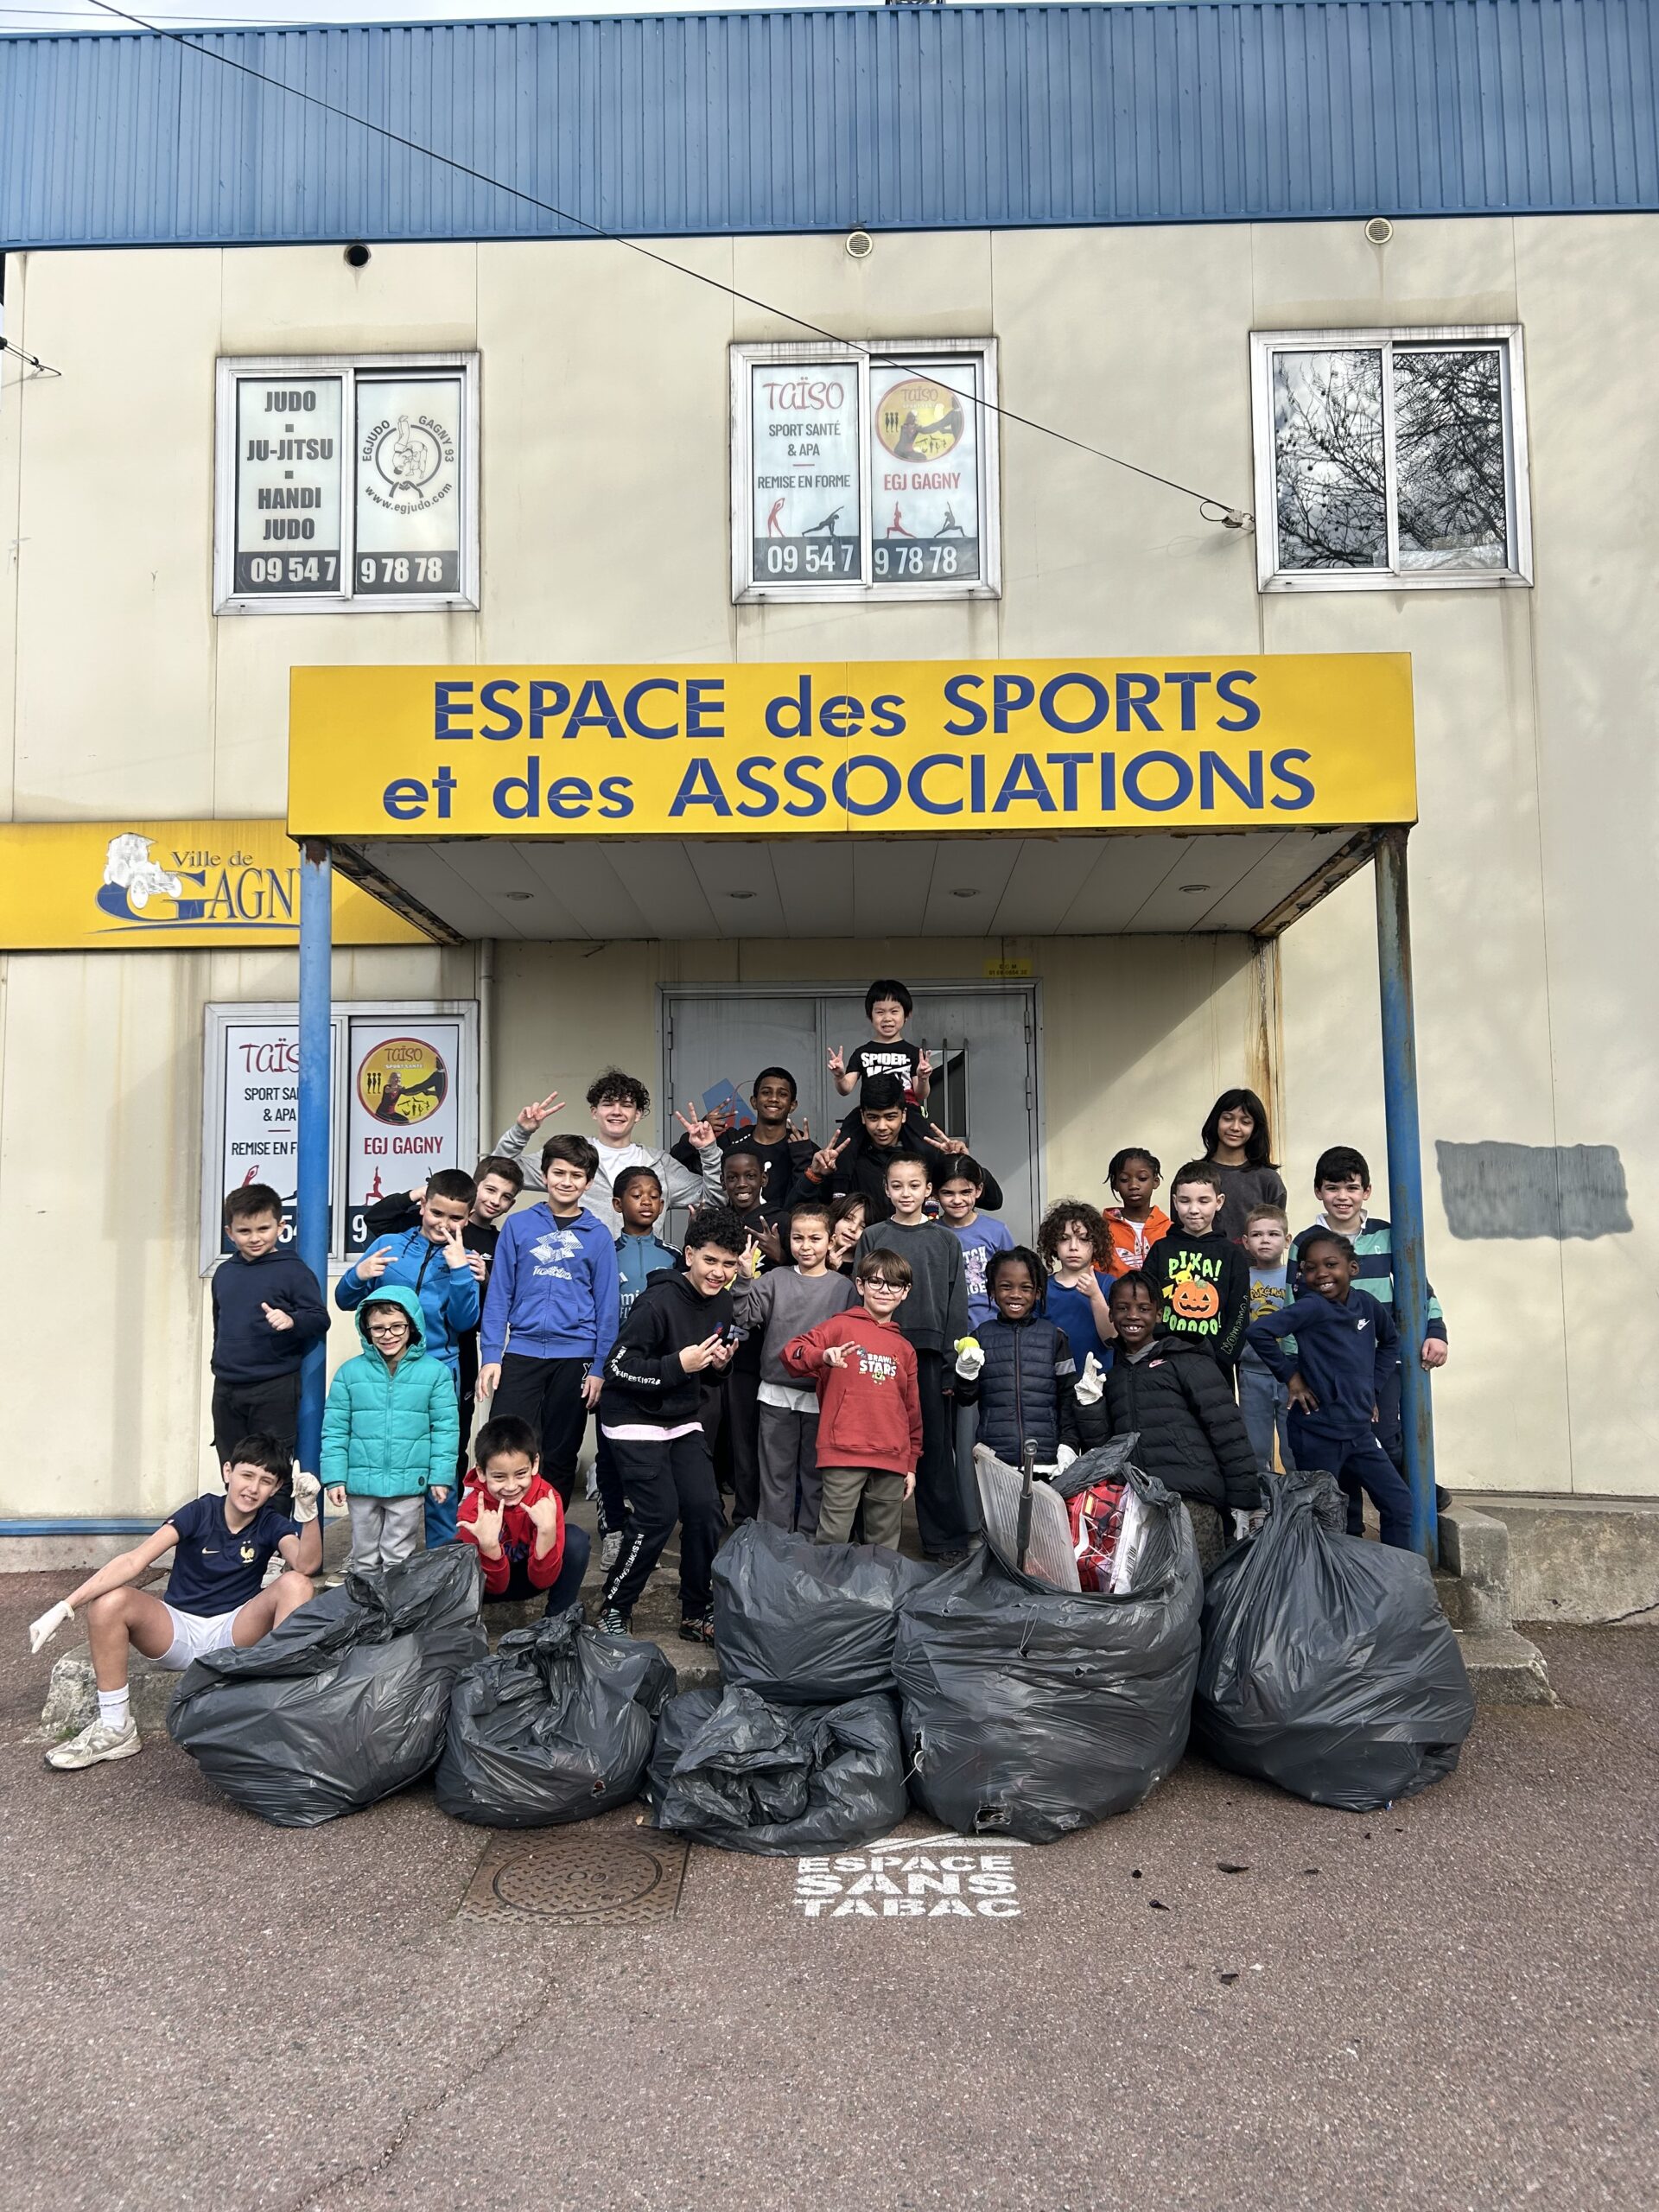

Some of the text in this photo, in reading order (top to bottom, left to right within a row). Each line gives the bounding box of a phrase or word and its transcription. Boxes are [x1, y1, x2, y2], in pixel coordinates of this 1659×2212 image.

[264, 391, 317, 412] JUDO
[362, 415, 454, 463] EGJUDO GAGNY 93
[768, 420, 841, 437] SPORT SANTÉ
[246, 438, 334, 461] JU-JITSU
[787, 443, 820, 456] & APA
[758, 474, 851, 489] REMISE EN FORME
[883, 473, 961, 491] EGJ GAGNY
[257, 487, 321, 510] HANDI
[365, 482, 453, 515] www.egjudo.com
[263, 518, 315, 541] JUDO
[251, 556, 442, 583] 09 54 7 9 78 78
[767, 544, 957, 575] 09 54 7 9 78 78
[435, 671, 1261, 741] ESPACE des SPORTS
[383, 749, 1315, 821] et des ASSOCIATIONS
[172, 850, 254, 868] Ville de
[95, 868, 301, 923] GAGN
[245, 1087, 281, 1101] SPORT
[263, 1108, 296, 1122] & APA
[232, 1142, 270, 1155] REMISE
[273, 1141, 288, 1155] EN
[364, 1136, 443, 1155] EGJ GAGNY
[278, 1214, 367, 1243] 5 9
[1168, 1250, 1223, 1282] PIKA!
[859, 1359, 897, 1377] STARS
[867, 1353, 893, 1365] BRAWL
[798, 1855, 1015, 1874] ESPACE
[795, 1872, 1018, 1895] SANS
[793, 1897, 1022, 1917] TABAC
